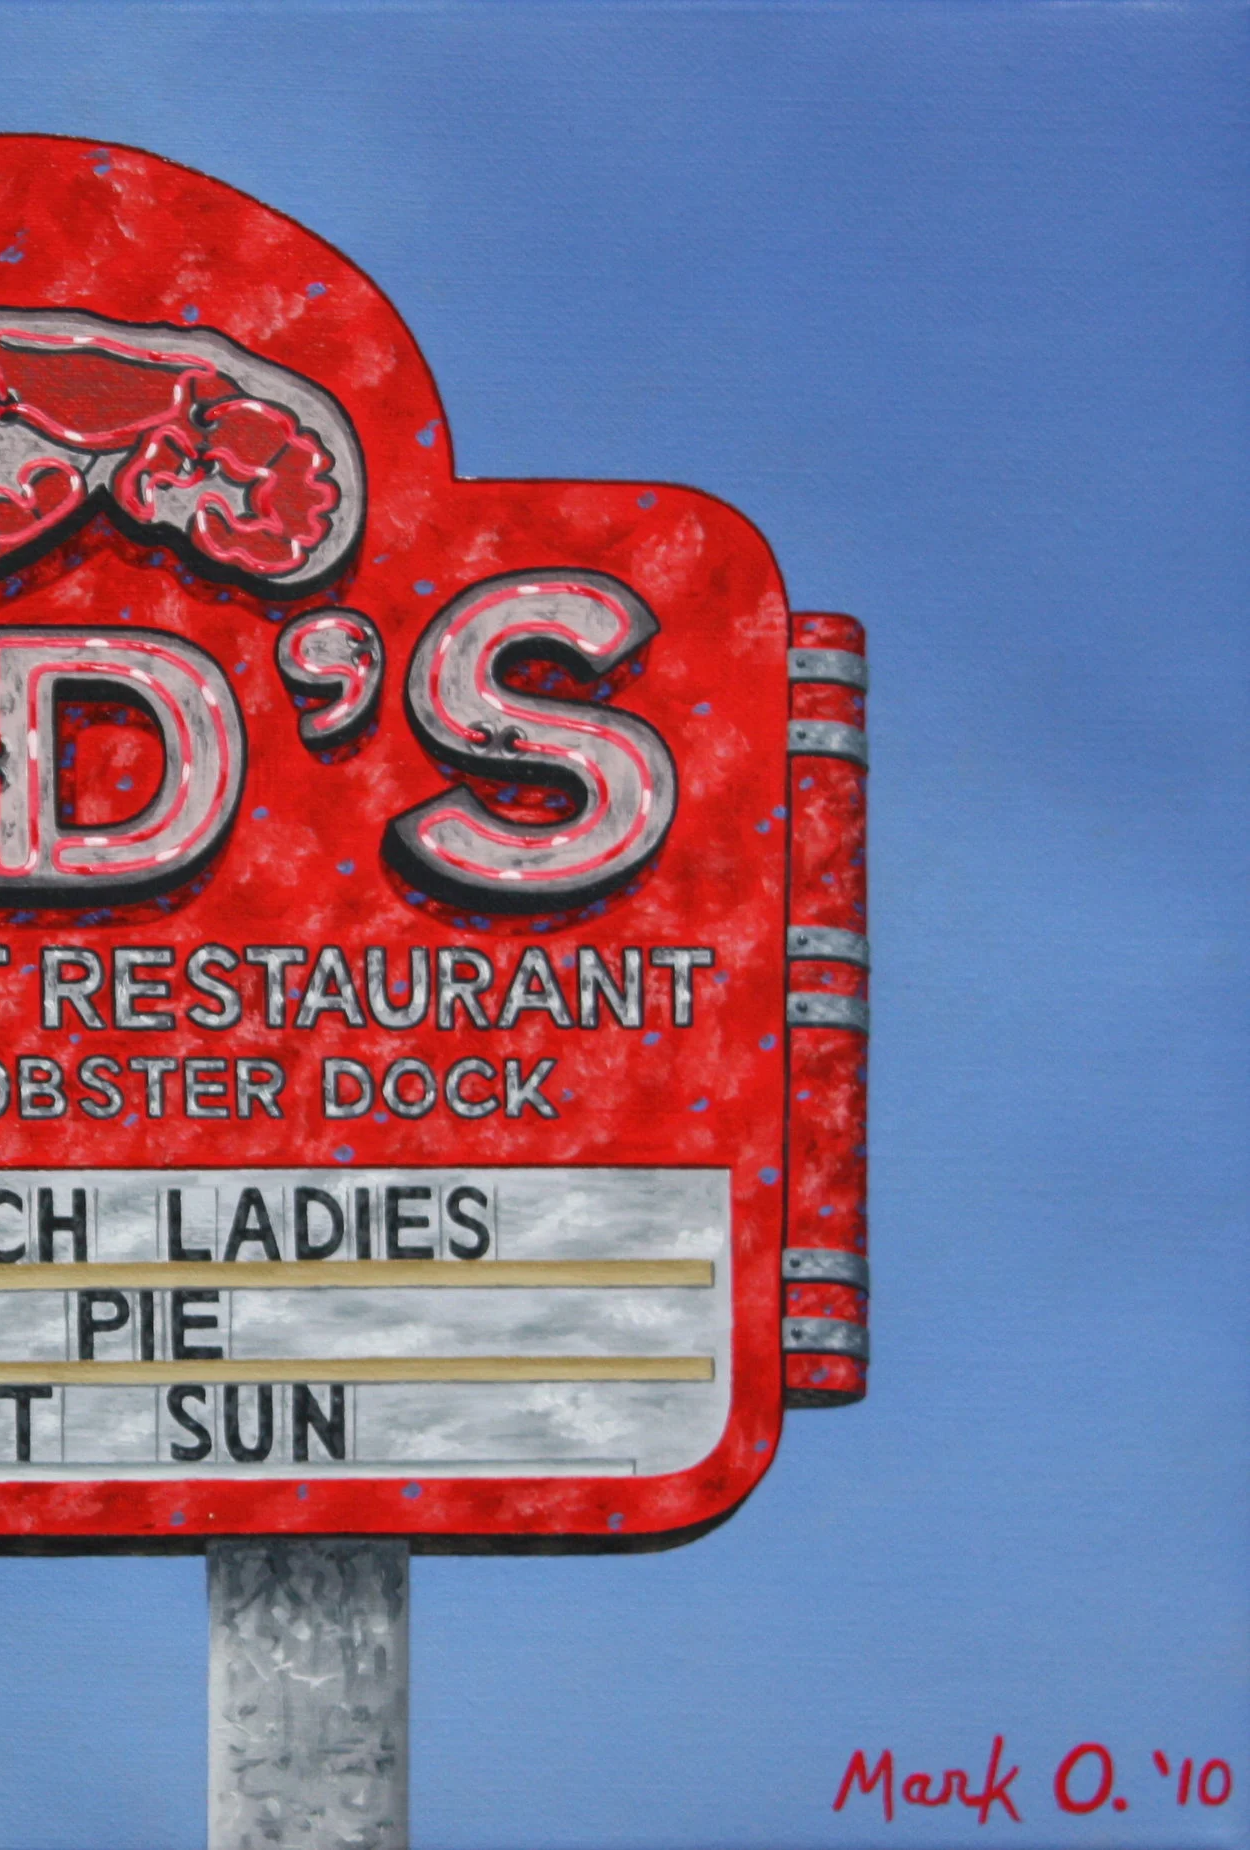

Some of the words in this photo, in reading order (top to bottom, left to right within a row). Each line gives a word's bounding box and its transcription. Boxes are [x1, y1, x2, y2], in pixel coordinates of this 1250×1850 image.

[40, 944, 714, 1029] RESTAURANT
[322, 1057, 555, 1120] DOCK
[166, 1186, 491, 1263] LADIES
[78, 1290, 223, 1362] PIE
[167, 1385, 349, 1463] SUN
[831, 1734, 1022, 1825] Mark
[1054, 1742, 1129, 1815] O.
